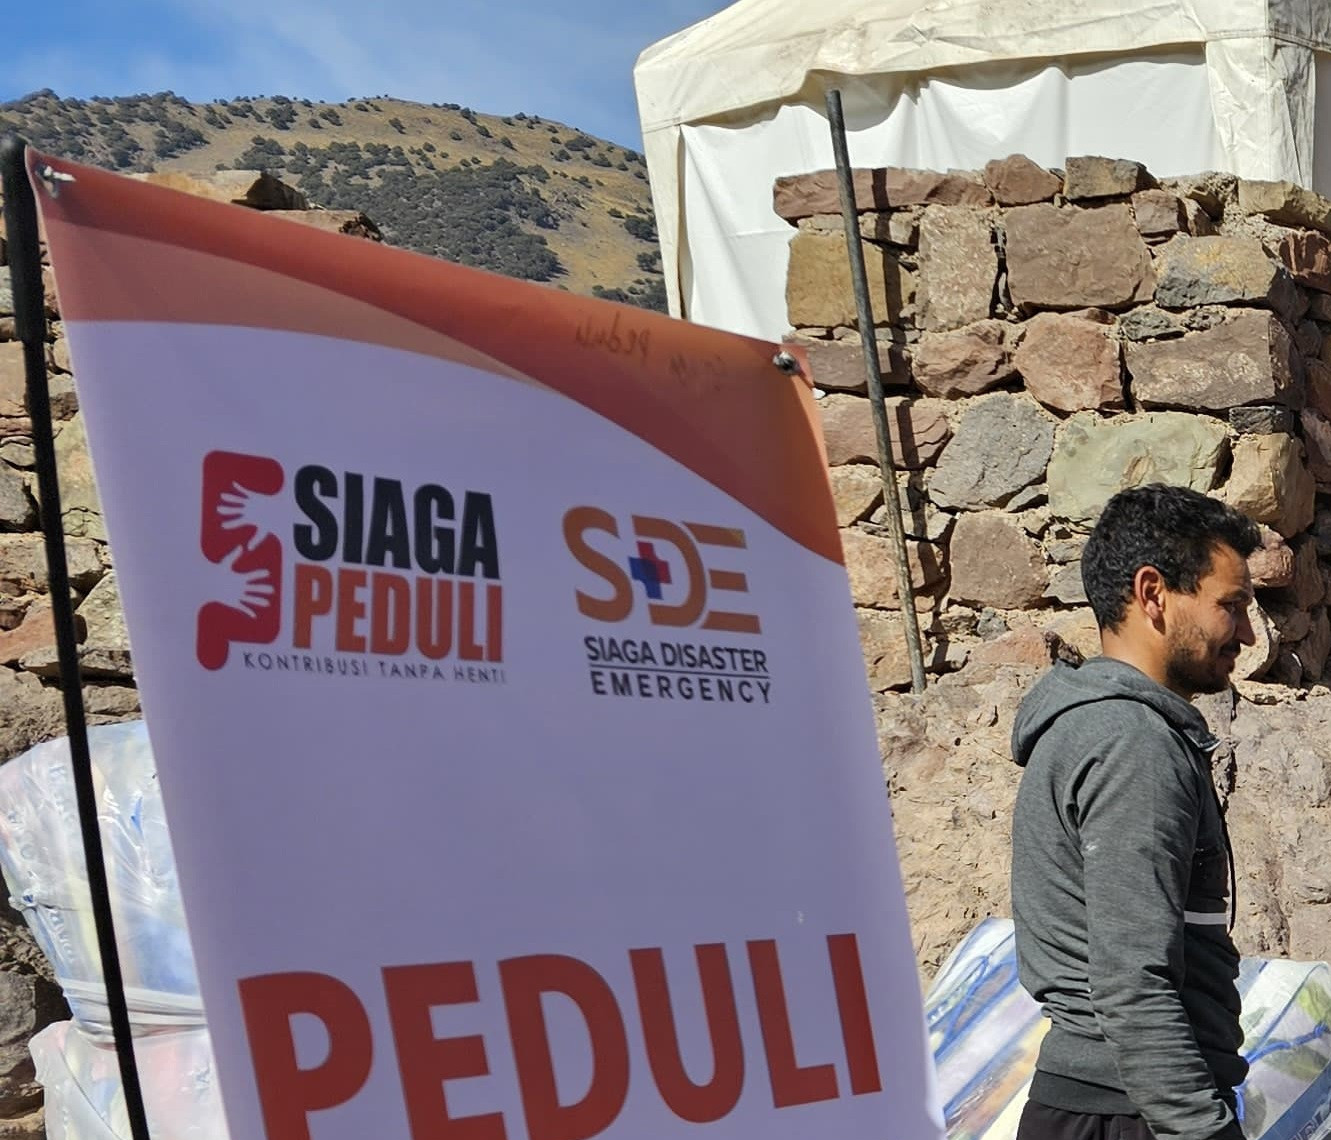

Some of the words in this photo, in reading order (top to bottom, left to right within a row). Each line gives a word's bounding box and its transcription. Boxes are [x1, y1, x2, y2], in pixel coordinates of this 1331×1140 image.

[293, 464, 500, 580] SIAGA
[562, 505, 762, 635] SDE
[293, 562, 503, 663] PEDULI
[243, 652, 368, 678] KONTRIBUSI
[378, 660, 446, 681] TANPA
[453, 666, 506, 684] HENTI
[583, 635, 657, 666] SIAGA
[660, 641, 769, 673] DISASTER
[590, 670, 771, 704] EMERGENCY
